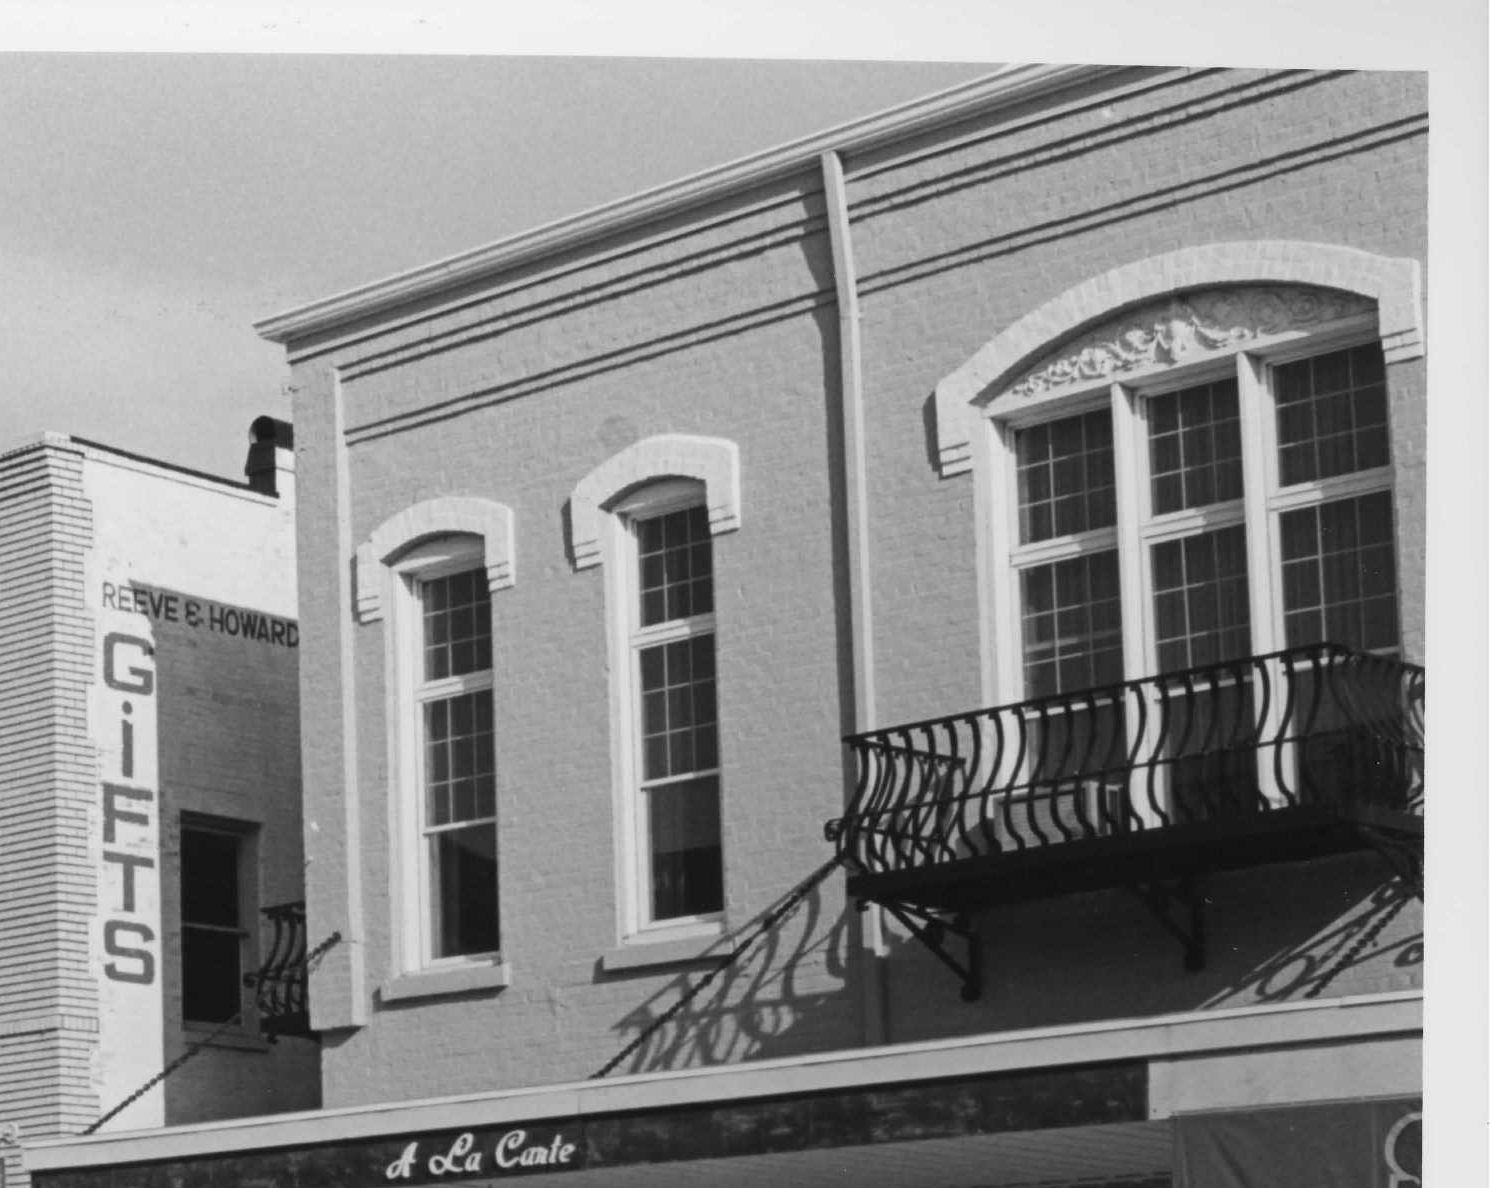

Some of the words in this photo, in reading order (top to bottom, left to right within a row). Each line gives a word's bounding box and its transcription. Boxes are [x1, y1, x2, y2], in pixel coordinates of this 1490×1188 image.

[102, 581, 179, 622] REEVE
[184, 600, 204, 627] &
[209, 605, 299, 648] HOWARD
[385, 1141, 419, 1179] A
[428, 1132, 482, 1175] La
[495, 1129, 576, 1169] Carte
